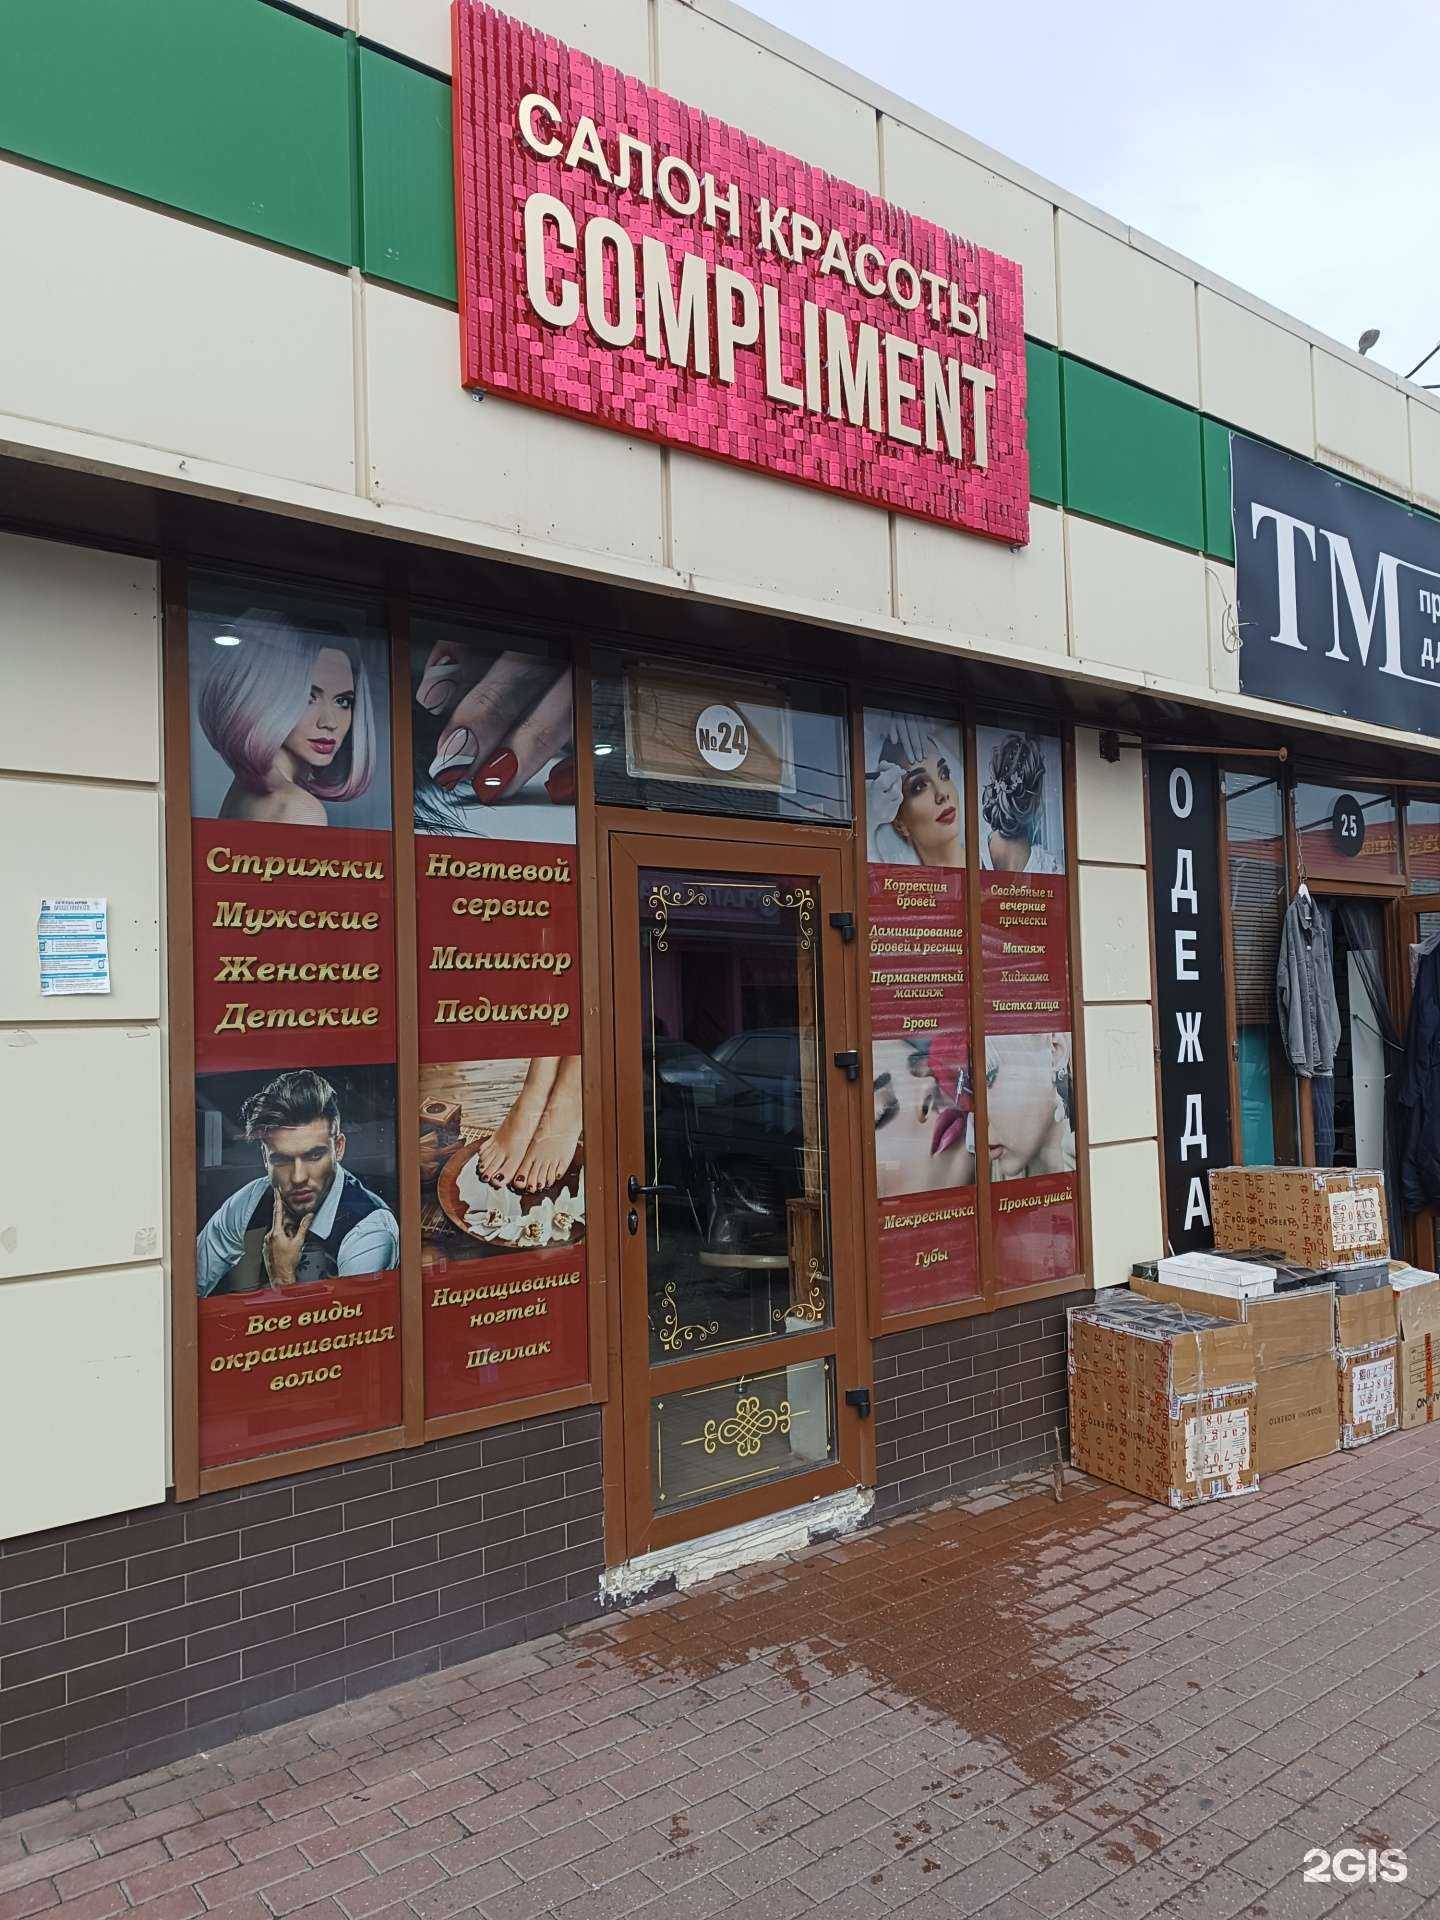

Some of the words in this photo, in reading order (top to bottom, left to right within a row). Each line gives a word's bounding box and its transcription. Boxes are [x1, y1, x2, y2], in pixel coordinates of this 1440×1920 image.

[518, 93, 740, 237] САЛОН
[759, 198, 988, 341] КРАСОТЫ
[523, 192, 995, 470] COMPLIMENT
[1341, 814, 1357, 837] 25
[206, 847, 385, 882] Стрижки
[425, 853, 571, 883] Ногтевой
[883, 878, 948, 896] Коррекция
[990, 884, 1046, 897] Свадебные
[451, 896, 551, 921] сервис
[896, 895, 937, 909] бровей
[999, 901, 1046, 913] вечерние
[211, 901, 380, 936] Мужские
[999, 916, 1048, 926] прически
[868, 925, 963, 939] Ламинирование
[870, 939, 912, 953] бровей
[922, 943, 963, 955] ресниц
[1002, 942, 1046, 954] Макияж
[213, 956, 380, 982] Женские
[429, 947, 572, 975] Маникюр
[871, 971, 964, 985] Перманентный
[1000, 970, 1049, 983] Хиджама
[893, 987, 944, 998] макияж
[1168, 766, 1211, 1231] ОДЕЖДА
[214, 1003, 379, 1034] Детские
[434, 997, 570, 1026] Педикюр
[992, 1000, 1034, 1012] Чистка
[1034, 1001, 1060, 1012] лица
[902, 1016, 938, 1031] Брови
[998, 1194, 1042, 1214] Прокол
[1043, 1186, 1073, 1207] ушей
[883, 1205, 975, 1230] Межресничка
[914, 1248, 949, 1268] Губы
[431, 1270, 581, 1308] Наращивание
[245, 1315, 292, 1337] Все
[297, 1300, 363, 1327] виды
[469, 1298, 548, 1328] ногтей
[209, 1325, 396, 1372] окрашивания
[465, 1339, 552, 1369] Шеллак
[269, 1363, 342, 1391] волос
